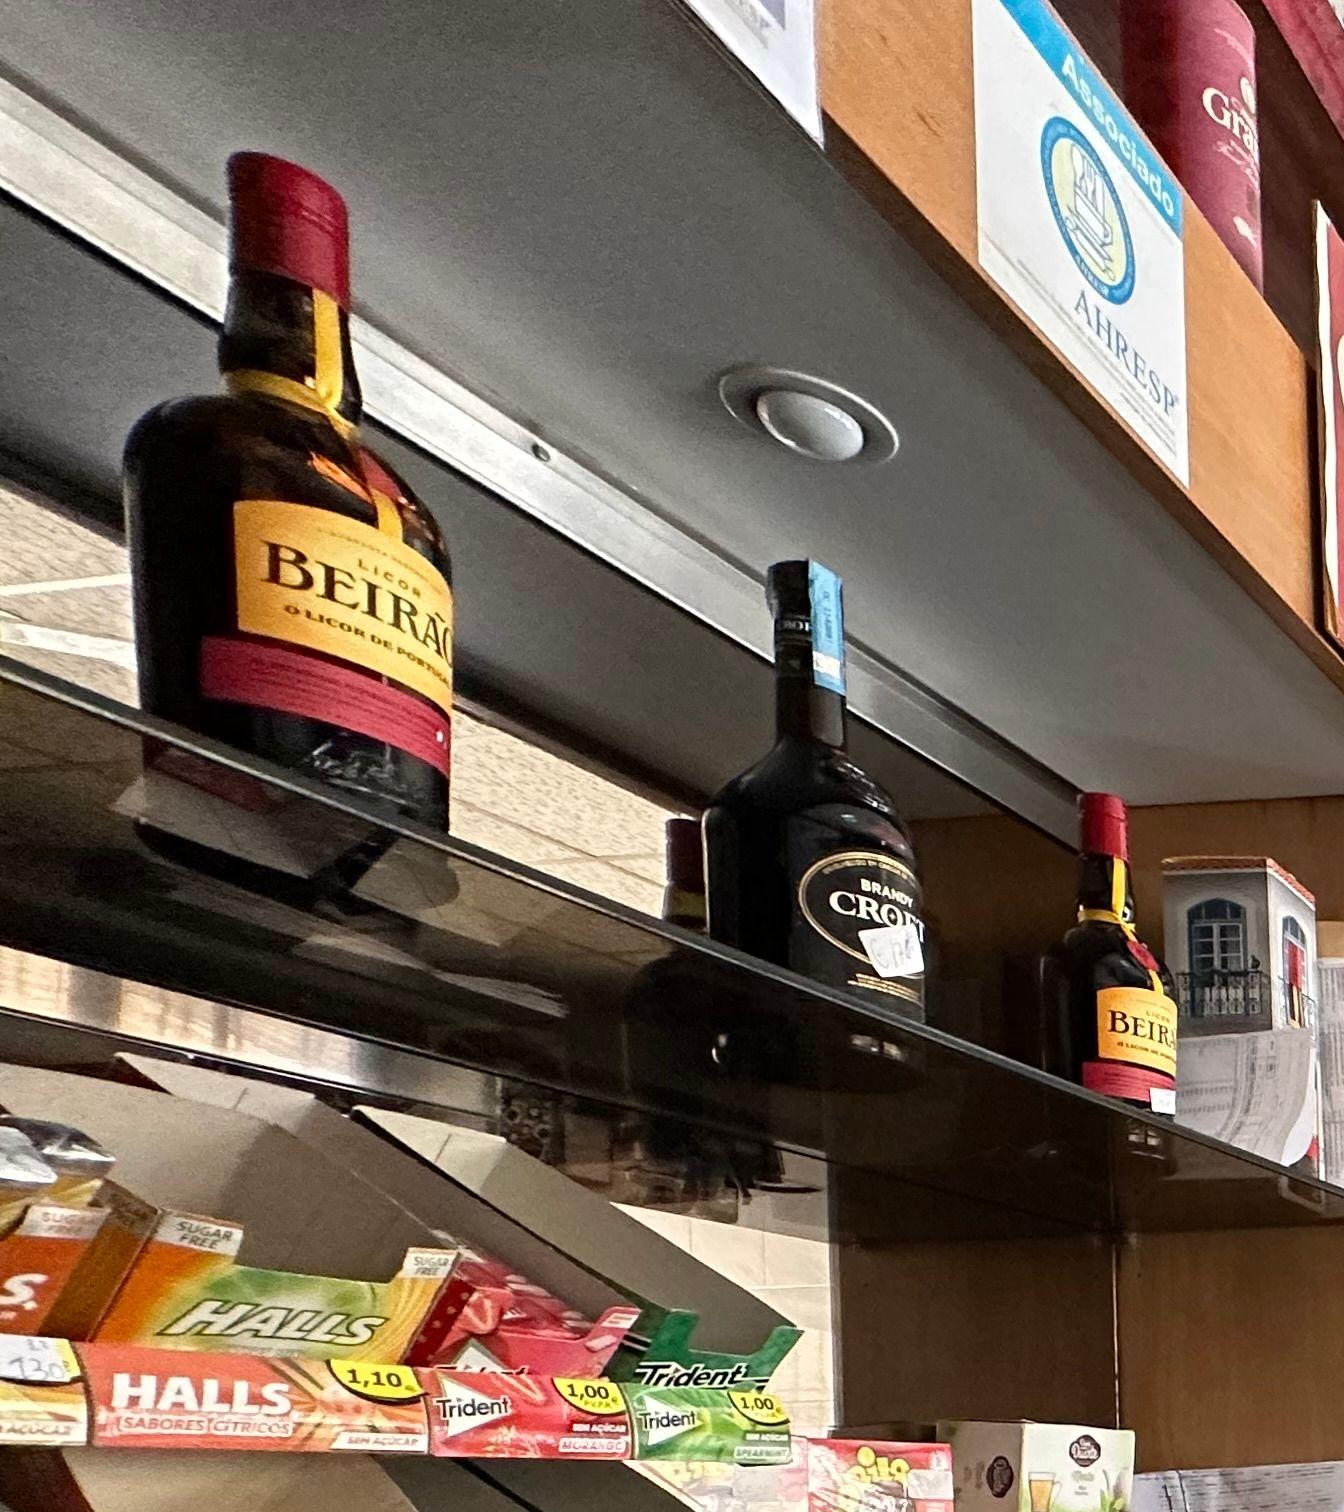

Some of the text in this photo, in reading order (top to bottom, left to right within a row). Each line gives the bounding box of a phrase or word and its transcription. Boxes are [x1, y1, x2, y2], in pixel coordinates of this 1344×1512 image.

[1060, 53, 1175, 218] Associado
[1073, 289, 1176, 416] AHRESP
[358, 558, 422, 598] LICOR
[304, 610, 366, 640] LICOR
[370, 633, 394, 653] DE
[860, 877, 914, 909] BRANDY
[176, 1220, 233, 1242] SUGAR
[179, 1233, 221, 1249] FREE
[154, 1299, 392, 1348] HALLS
[346, 1367, 403, 1388] 1,10
[638, 1362, 749, 1388] Trident
[566, 1383, 610, 1400] 1,00
[740, 1396, 775, 1411] 1,00
[435, 1394, 511, 1421] Trident
[122, 1416, 205, 1433] SABORES
[638, 1411, 697, 1431] Trident
